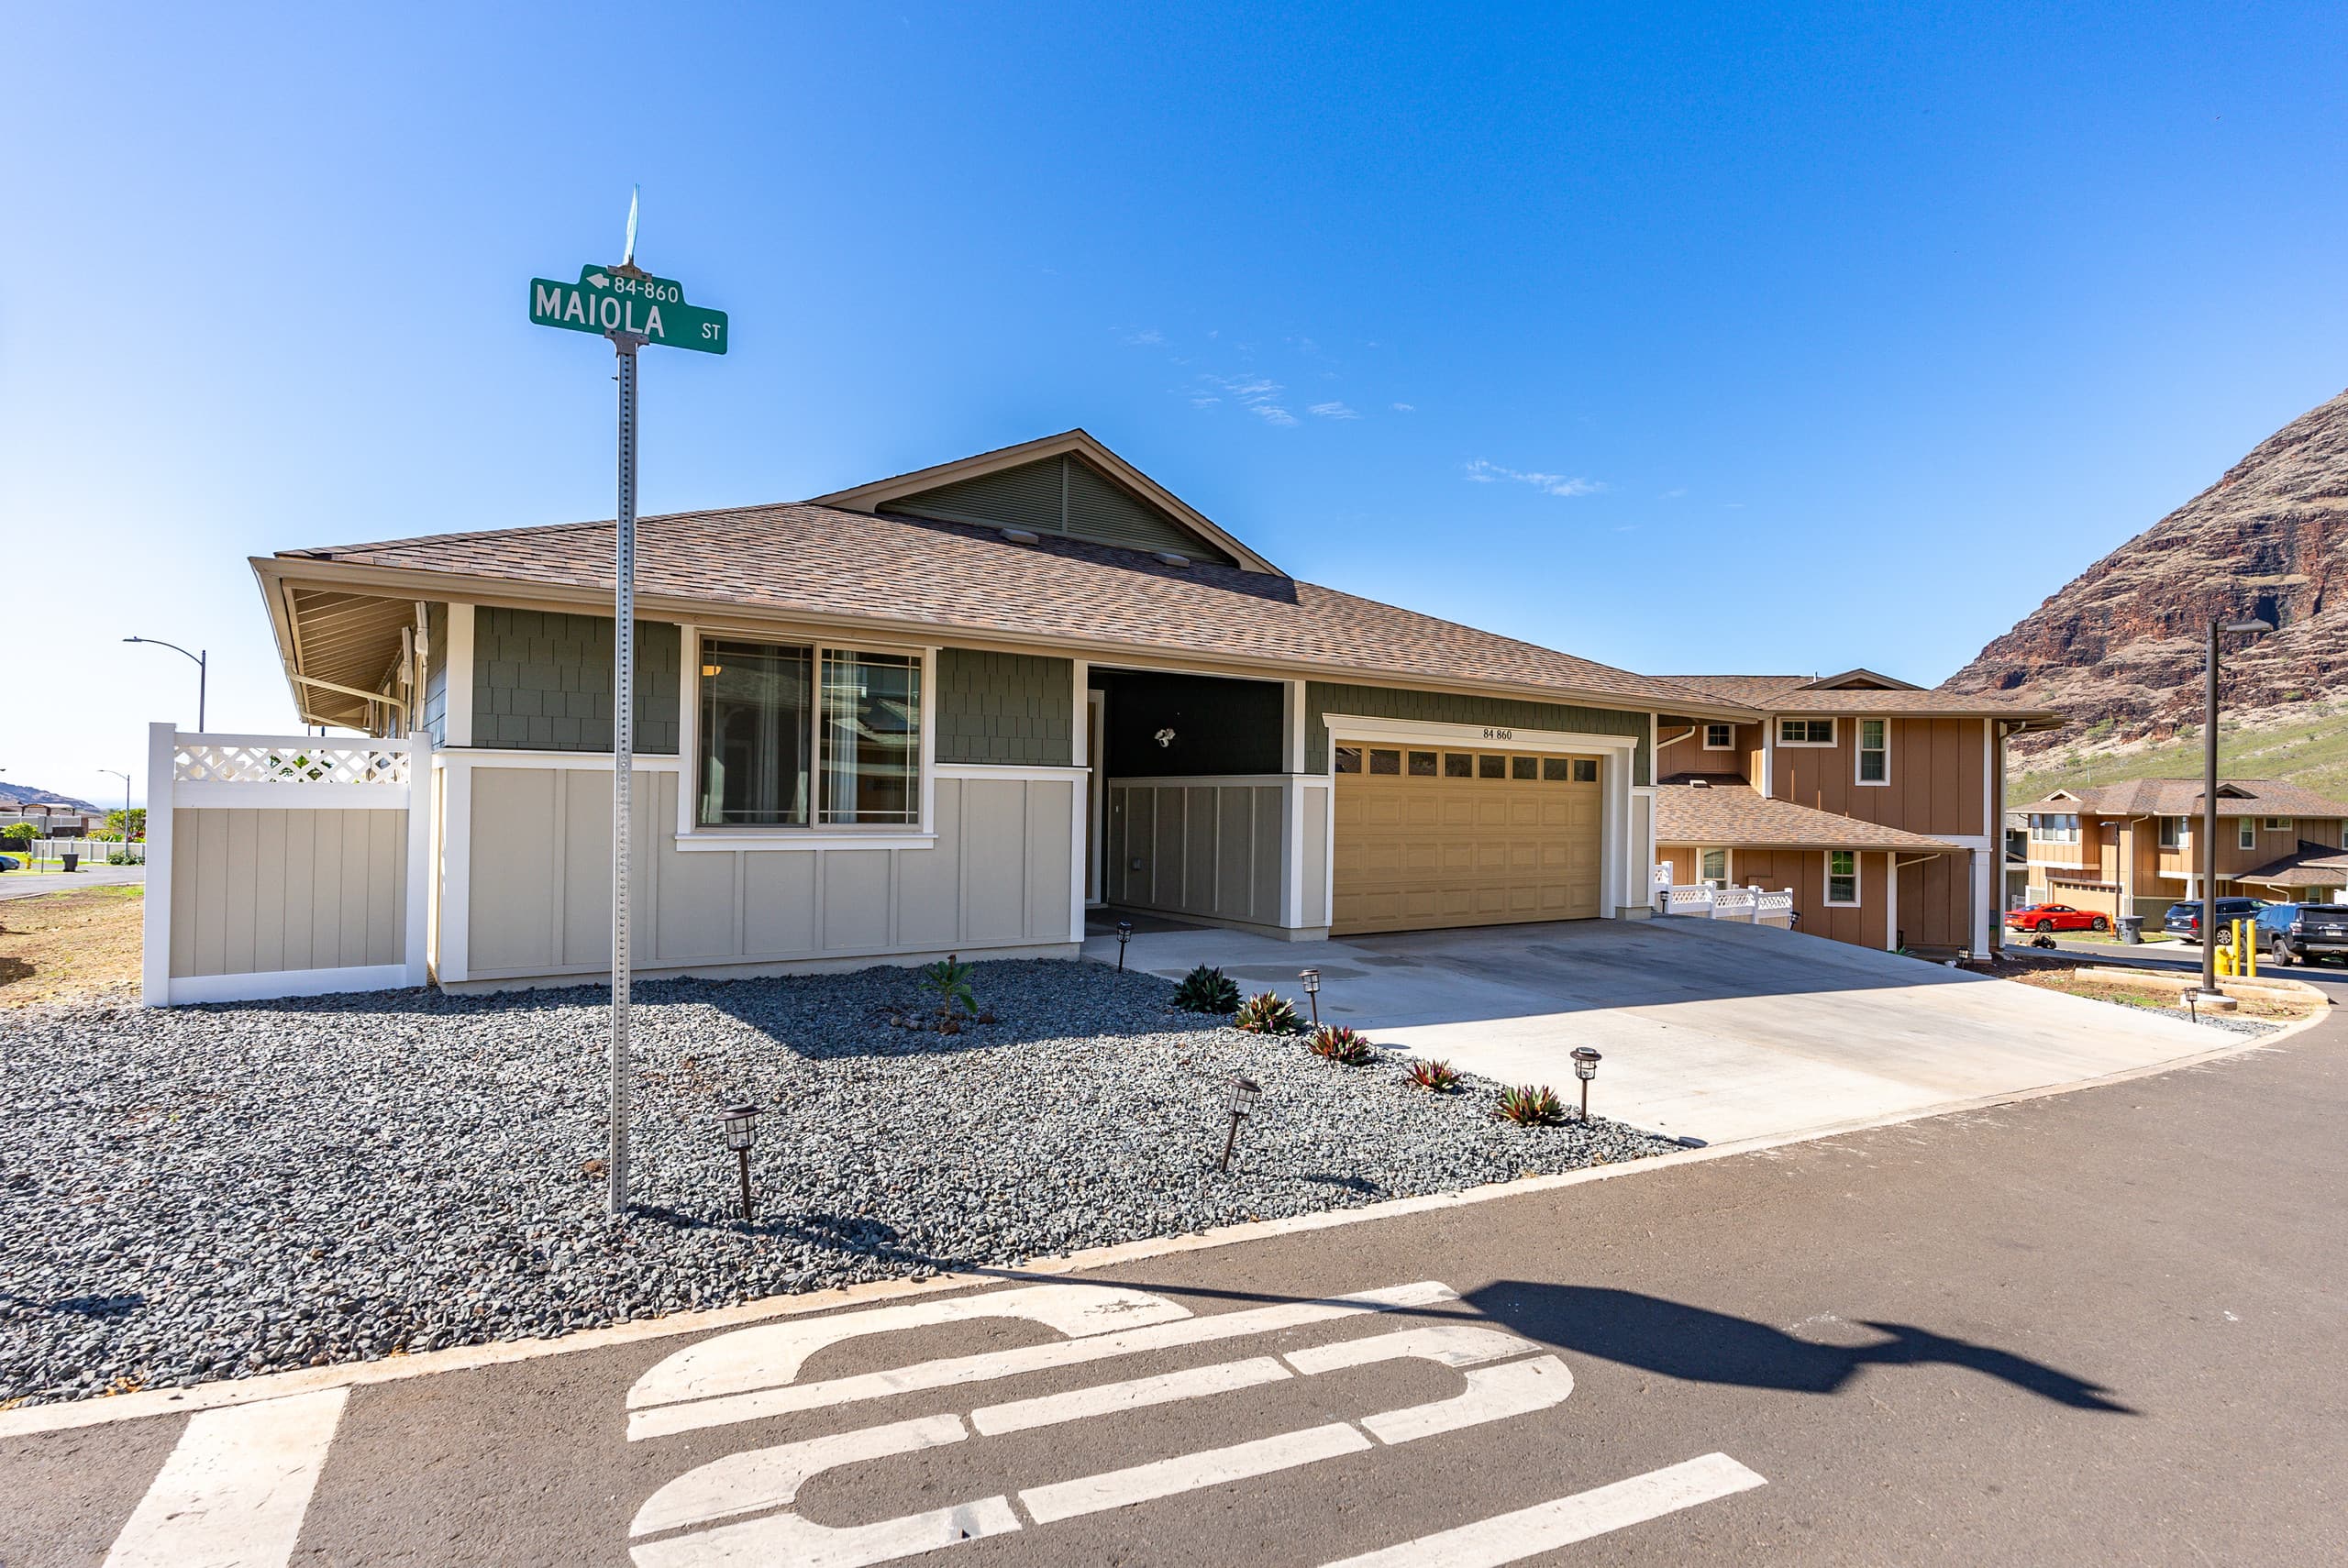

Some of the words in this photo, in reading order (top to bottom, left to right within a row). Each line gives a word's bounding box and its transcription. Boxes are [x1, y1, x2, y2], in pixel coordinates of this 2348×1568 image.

[614, 277, 679, 304] 84-860
[536, 284, 665, 338] MAIOLA
[702, 323, 721, 340] ST
[1483, 728, 1493, 739] 84
[1496, 729, 1512, 740] 860
